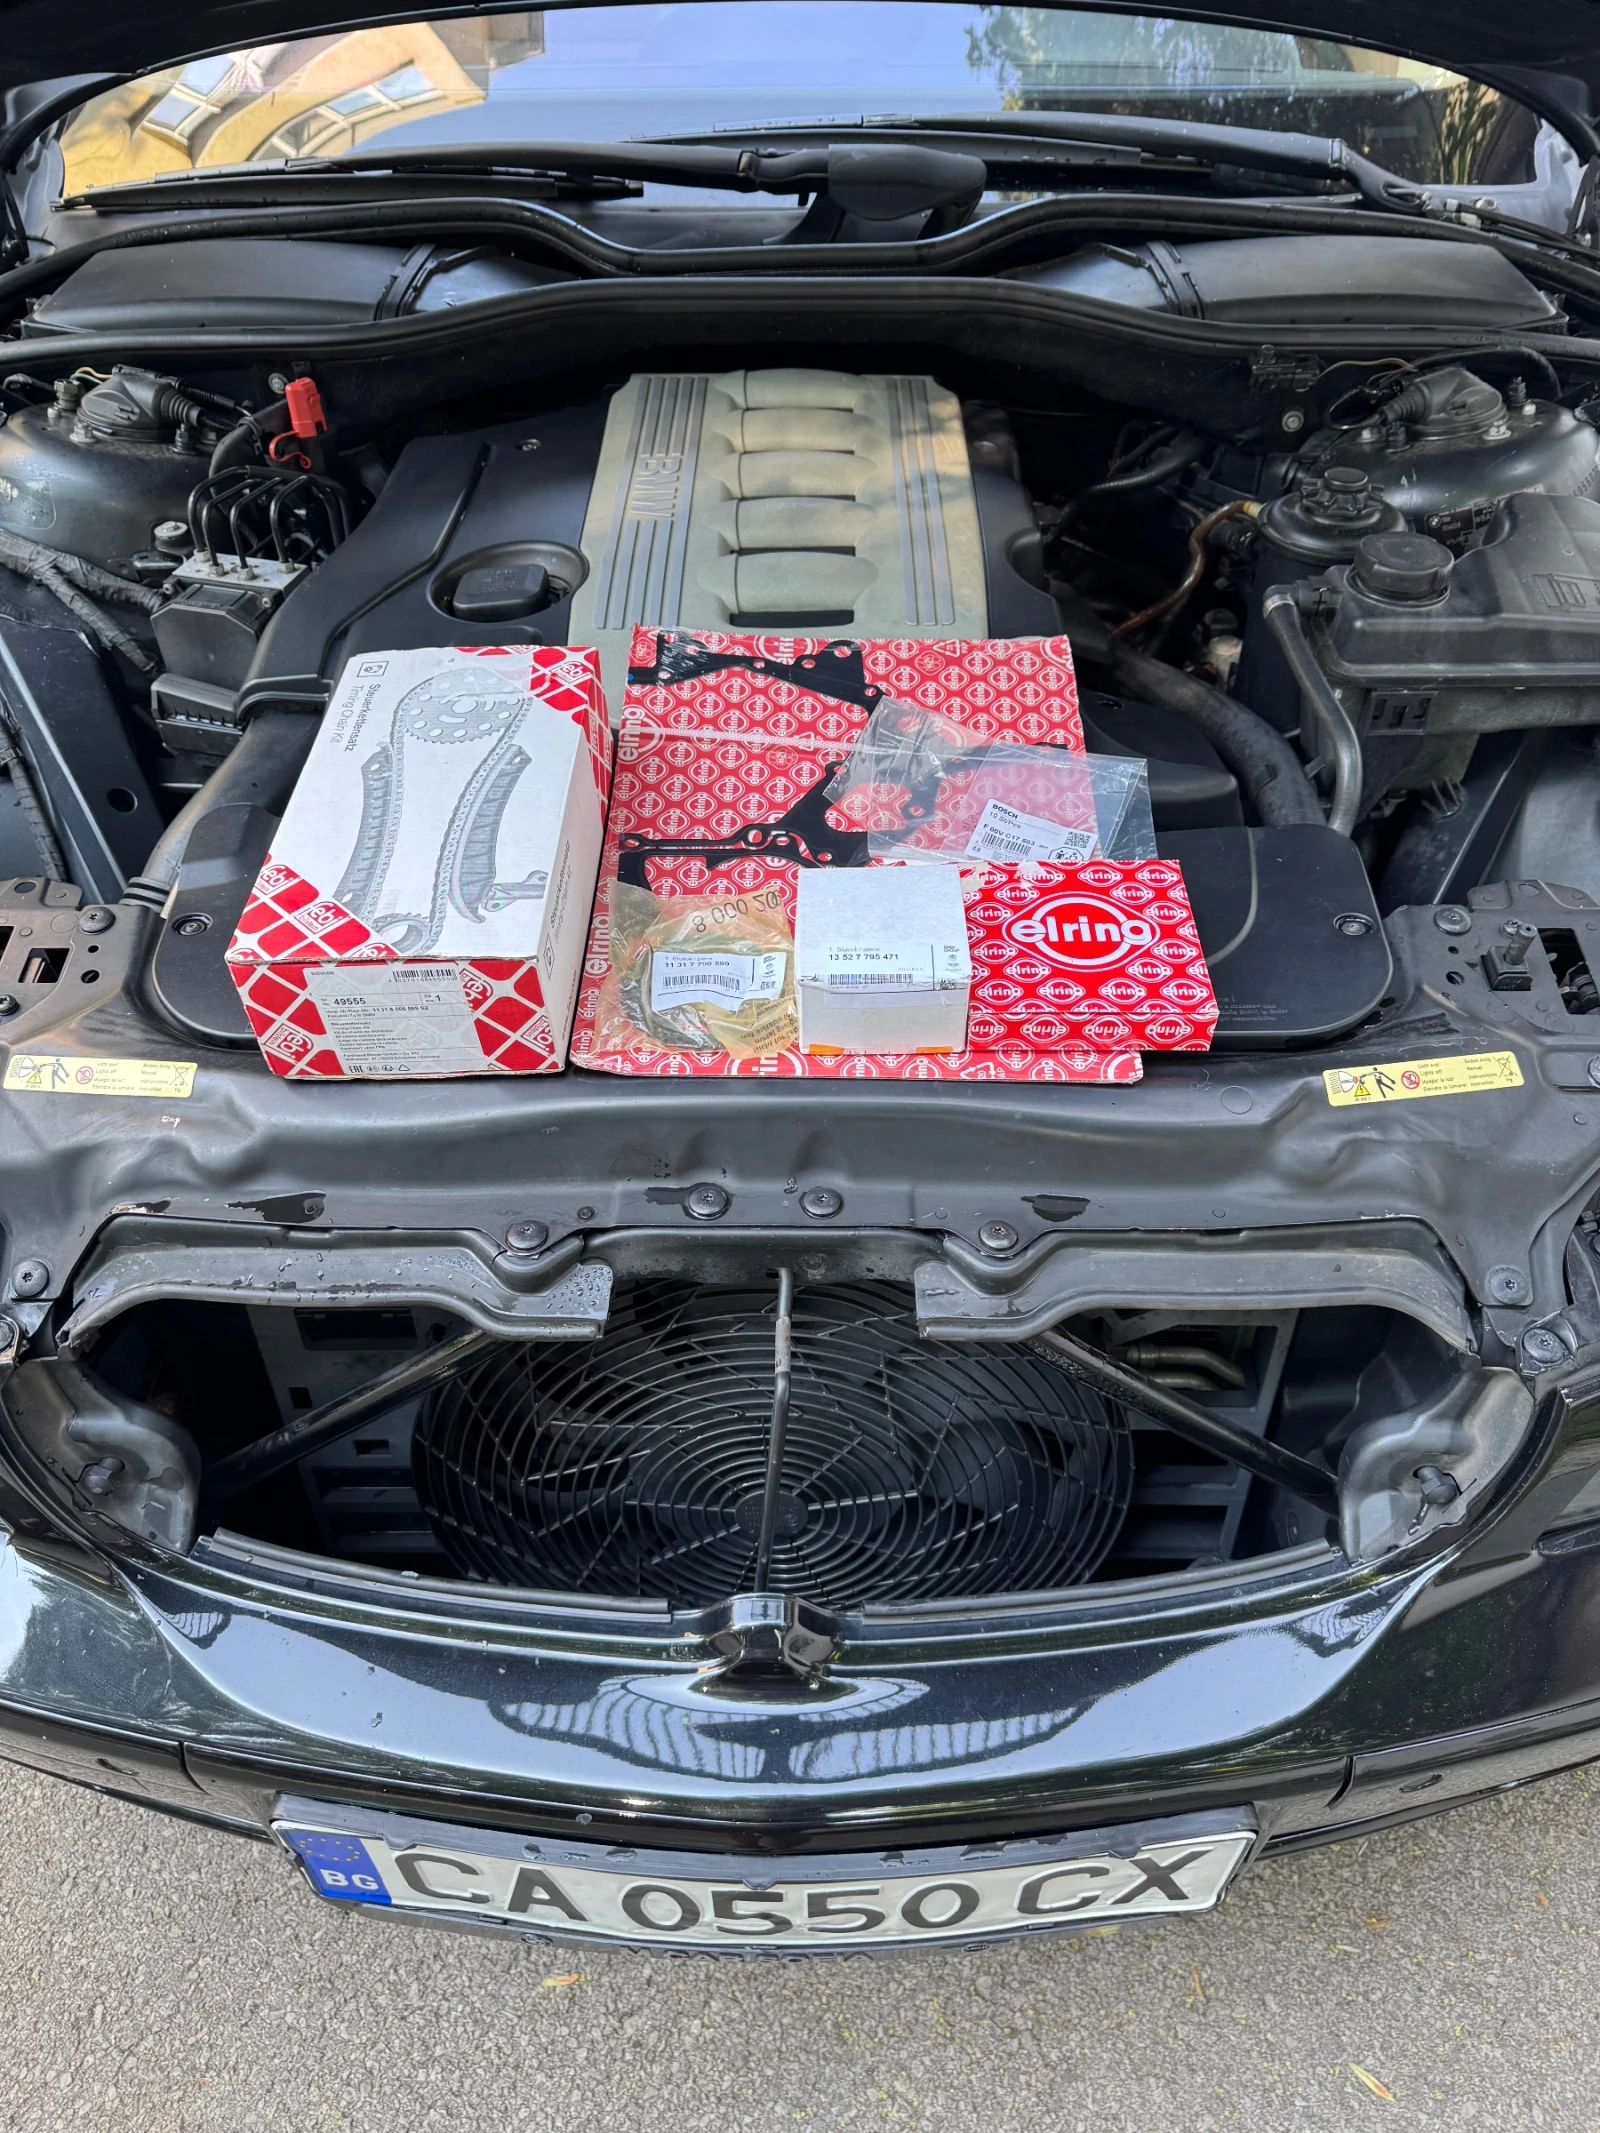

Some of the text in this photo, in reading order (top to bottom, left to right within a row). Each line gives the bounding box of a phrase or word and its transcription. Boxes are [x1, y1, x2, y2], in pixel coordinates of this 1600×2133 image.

[631, 455, 681, 517] BMW
[342, 685, 364, 708] Timing
[337, 709, 353, 731] Chain
[345, 684, 381, 751] Steuerkettensatz
[617, 708, 646, 760] elring
[992, 804, 1018, 819] BOSCH
[989, 811, 1021, 829] 10 St/Pcs
[989, 826, 1005, 836] 00V
[1005, 831, 1021, 841] C17
[688, 861, 701, 887] elring
[743, 861, 755, 888] elring
[1079, 871, 1121, 881] elring
[1137, 871, 1179, 881] elring
[996, 889, 1038, 899] elring
[1112, 889, 1154, 899] elring
[311, 901, 344, 927] febi
[970, 909, 1011, 919] elring
[1145, 907, 1187, 918] elring
[1011, 916, 1153, 945] elring
[585, 915, 610, 975] elring
[974, 946, 1016, 957] elring
[1154, 946, 1197, 957] elring
[1006, 966, 1050, 975] elring
[1128, 965, 1172, 976] elring
[978, 987, 1022, 997] elring
[1039, 986, 1084, 997] elring
[1101, 986, 1147, 997] elring
[1162, 986, 1208, 998] elring
[333, 996, 366, 1006] 49555
[584, 988, 600, 1018] elring
[1022, 1025, 1067, 1035] elring
[1085, 1025, 1129, 1036] elring
[1146, 1025, 1193, 1036] elring
[280, 1032, 313, 1059] febi
[321, 1868, 379, 1891] BG
[399, 1846, 1212, 1936] CA 0550 CX
